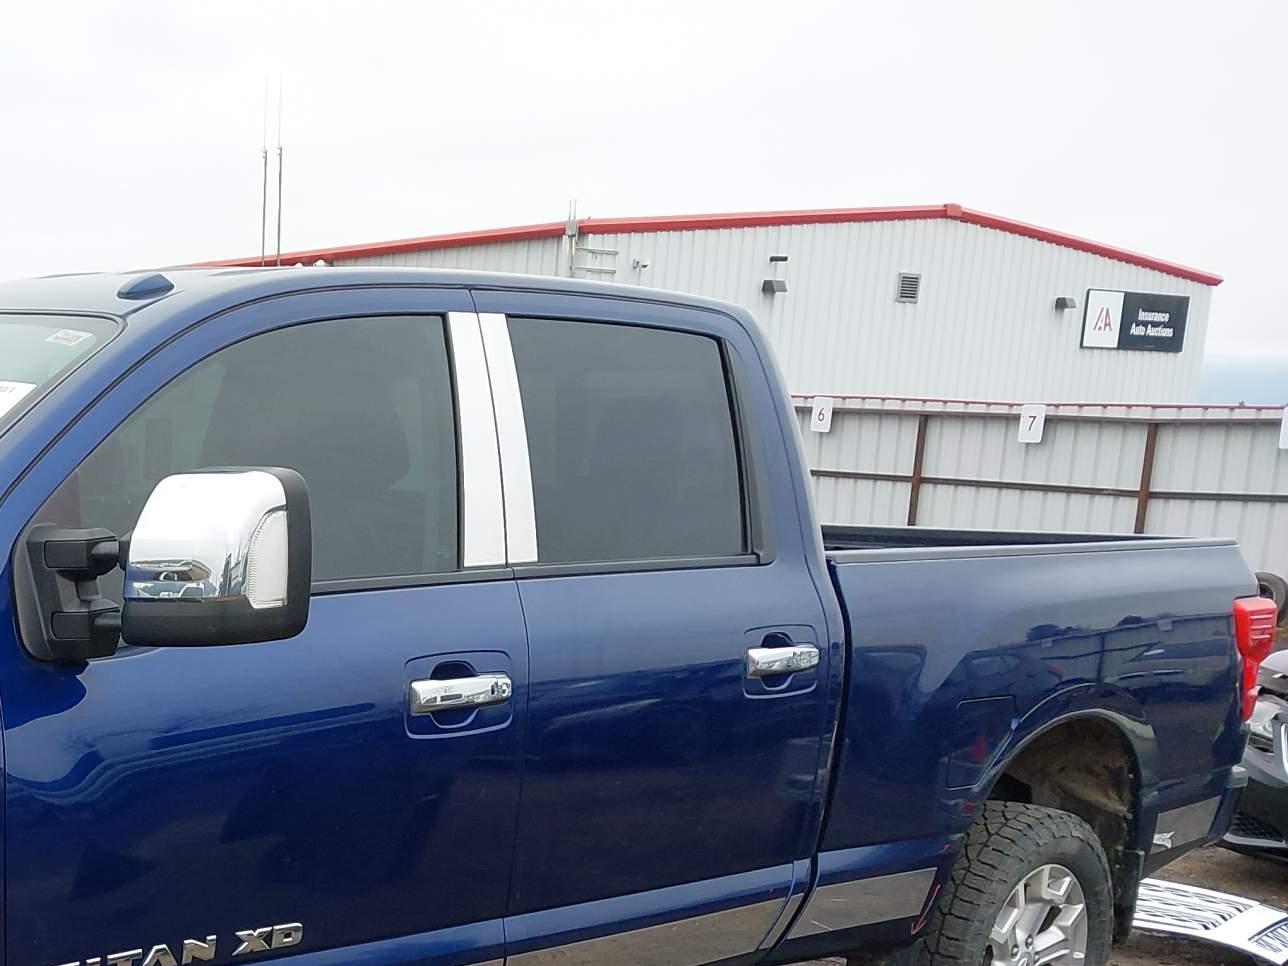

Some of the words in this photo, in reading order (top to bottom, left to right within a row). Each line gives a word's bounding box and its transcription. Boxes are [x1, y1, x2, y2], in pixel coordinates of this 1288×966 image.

[1138, 307, 1170, 322] Insurance
[1130, 321, 1146, 336] Auto
[1145, 322, 1174, 337] Auctions
[817, 407, 825, 422] 6
[1027, 415, 1037, 431] 7
[231, 922, 304, 956] XD
